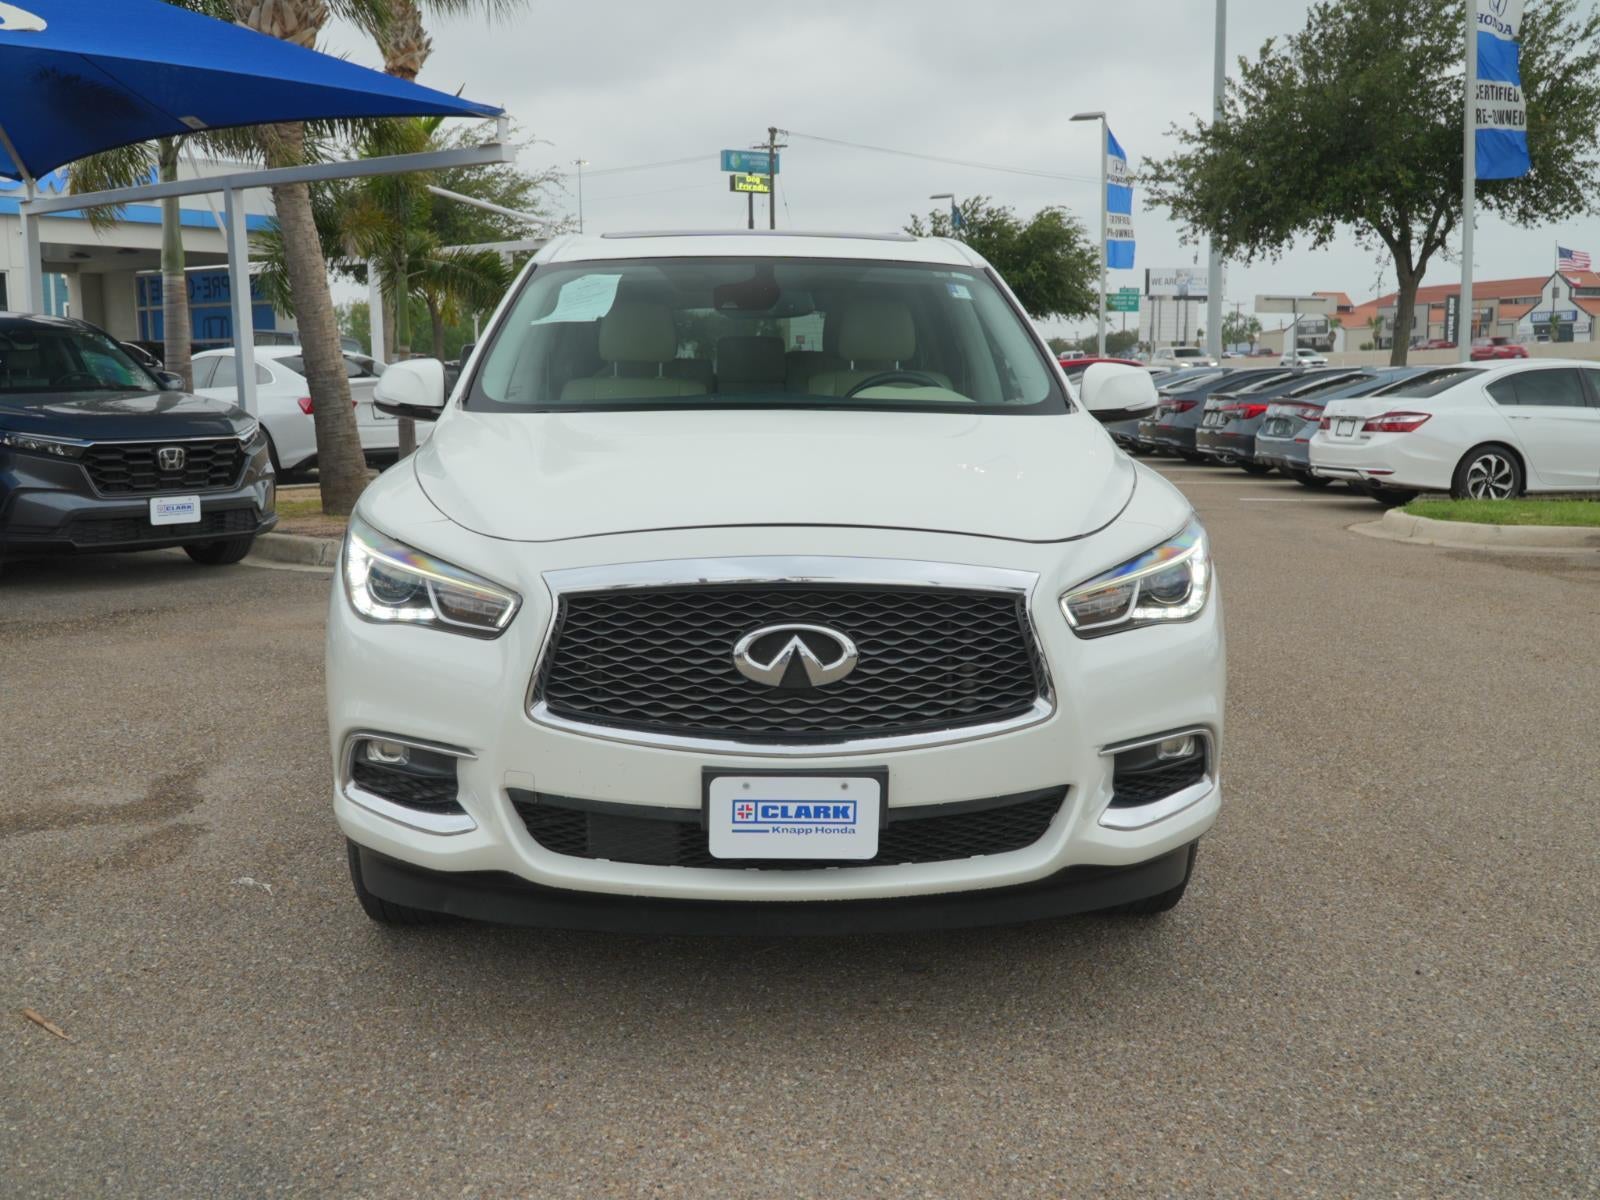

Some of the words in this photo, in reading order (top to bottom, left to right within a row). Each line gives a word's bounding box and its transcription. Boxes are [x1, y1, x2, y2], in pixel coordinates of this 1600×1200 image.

[1475, 84, 1520, 102] ERTIFIED
[1475, 108, 1525, 126] RE-OWNED
[746, 176, 760, 184] Dog
[1151, 278, 1162, 286] WE
[761, 805, 850, 819] CLARK
[772, 826, 812, 835] Knapp
[815, 826, 856, 834] Honda
